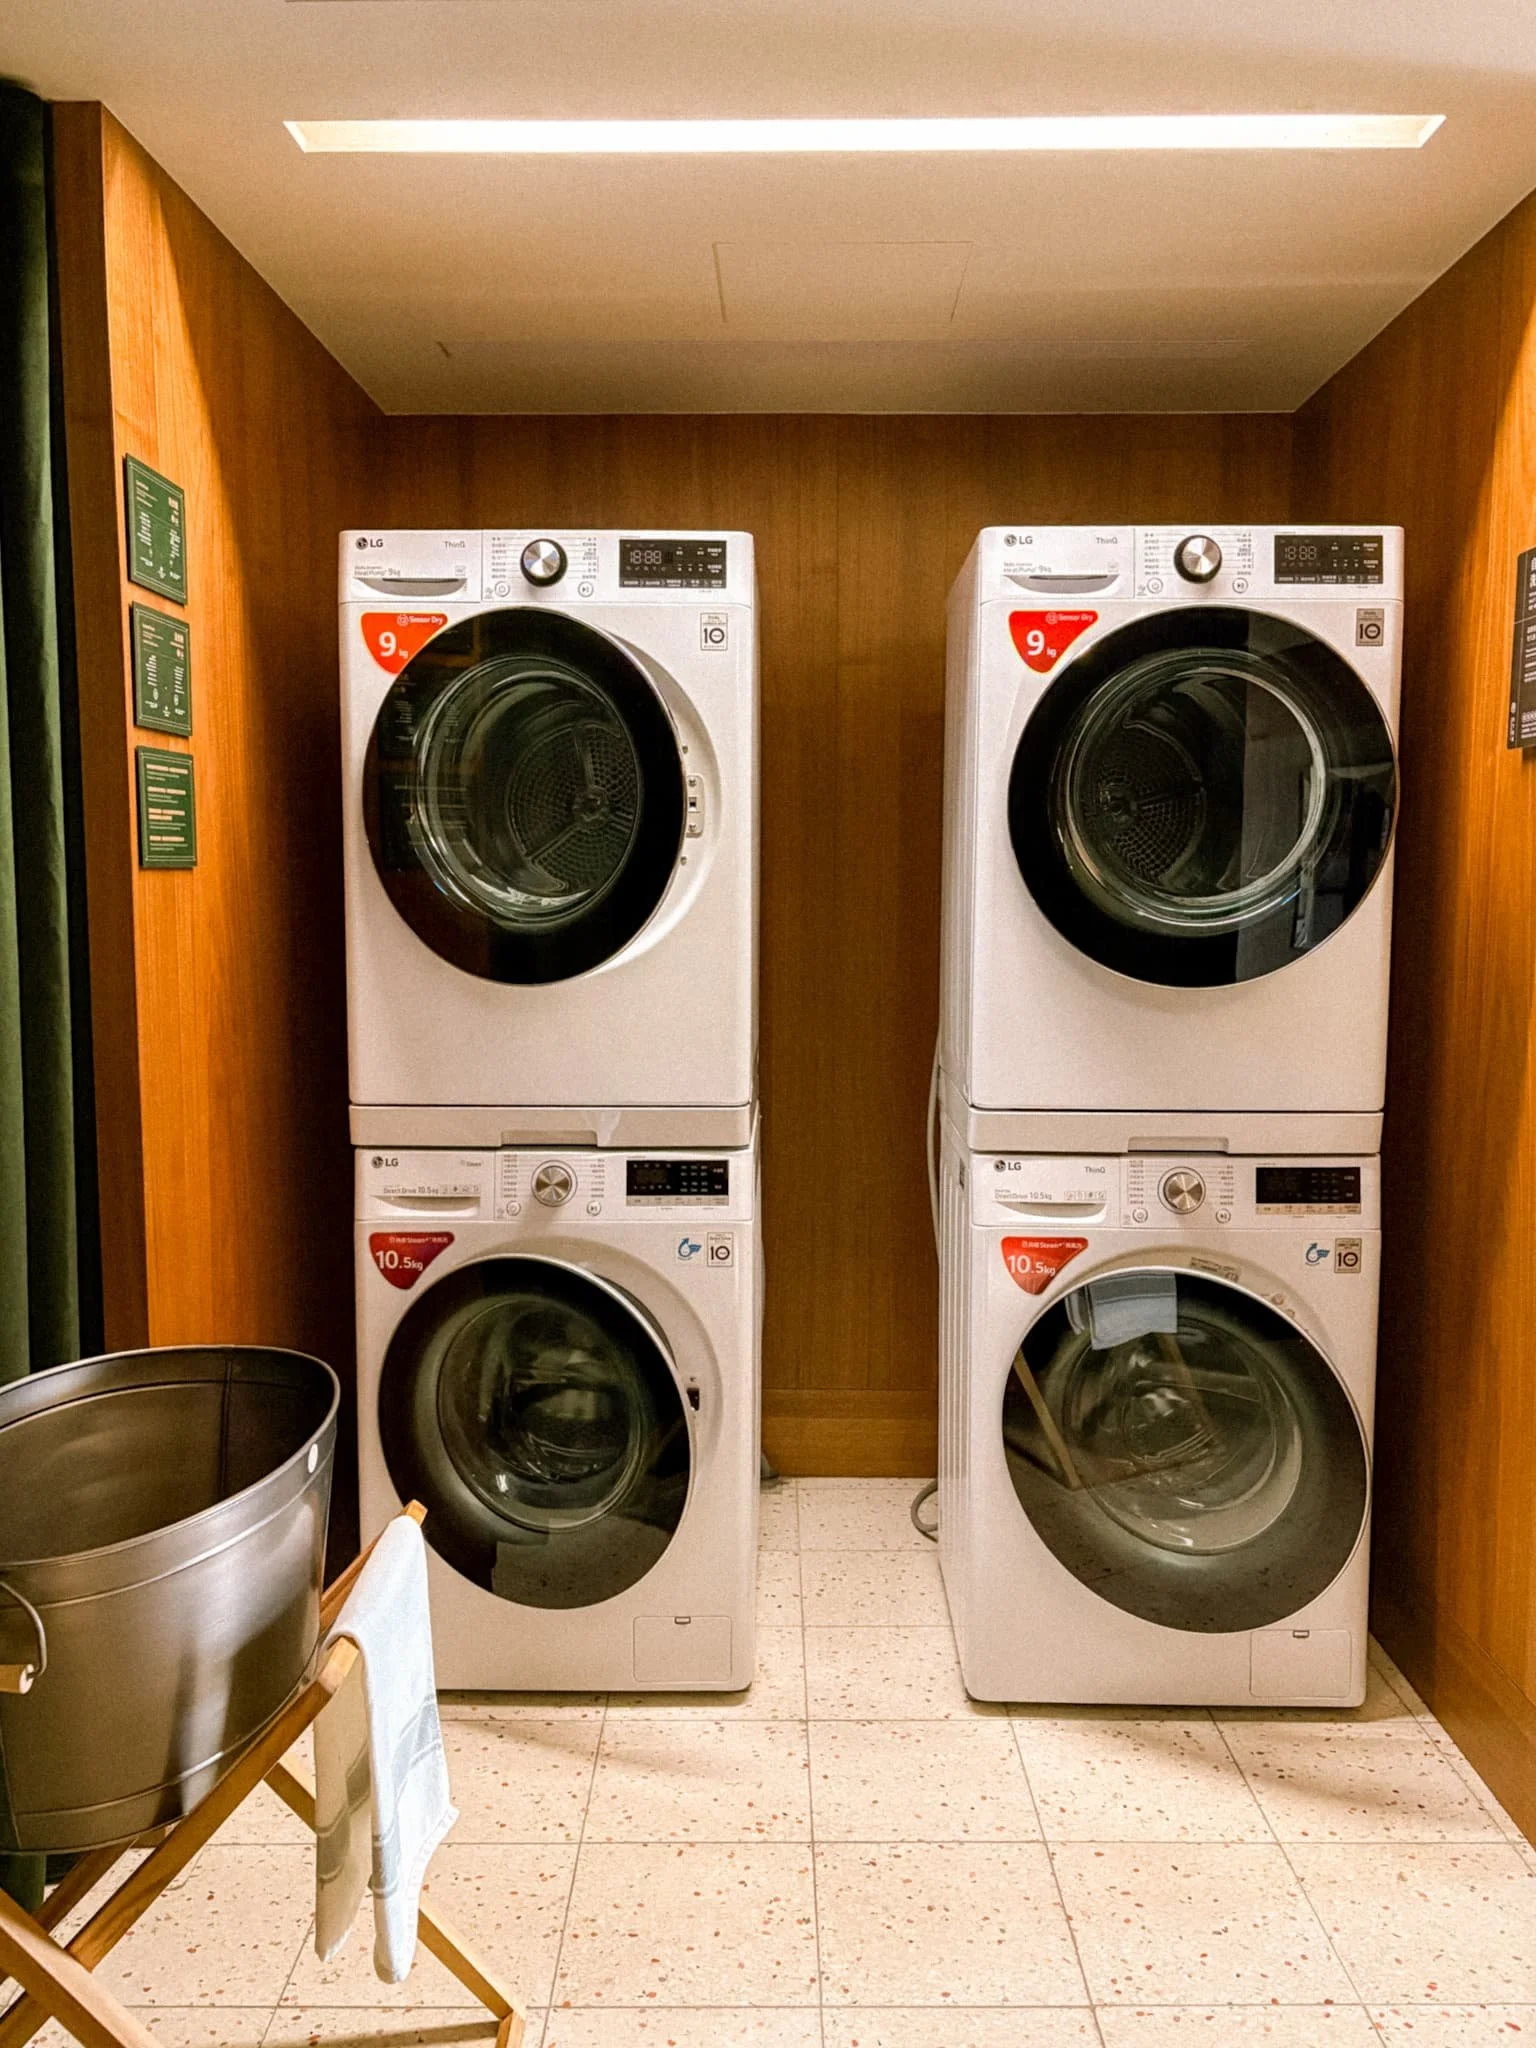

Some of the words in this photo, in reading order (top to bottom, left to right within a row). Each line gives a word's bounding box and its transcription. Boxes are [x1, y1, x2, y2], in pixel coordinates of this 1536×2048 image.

[370, 539, 384, 548] LG
[444, 541, 466, 549] ThinQ
[1019, 536, 1033, 545] LG
[1096, 537, 1118, 545] ThinQ
[379, 631, 397, 657] 9
[1026, 629, 1045, 656] 9
[1046, 647, 1057, 658] kg
[385, 1158, 399, 1167] LG
[1007, 1162, 1022, 1171] LG
[1084, 1166, 1106, 1174] ThinQ
[375, 1250, 424, 1272] 10.5kg
[1007, 1255, 1056, 1277] 10.5kg
